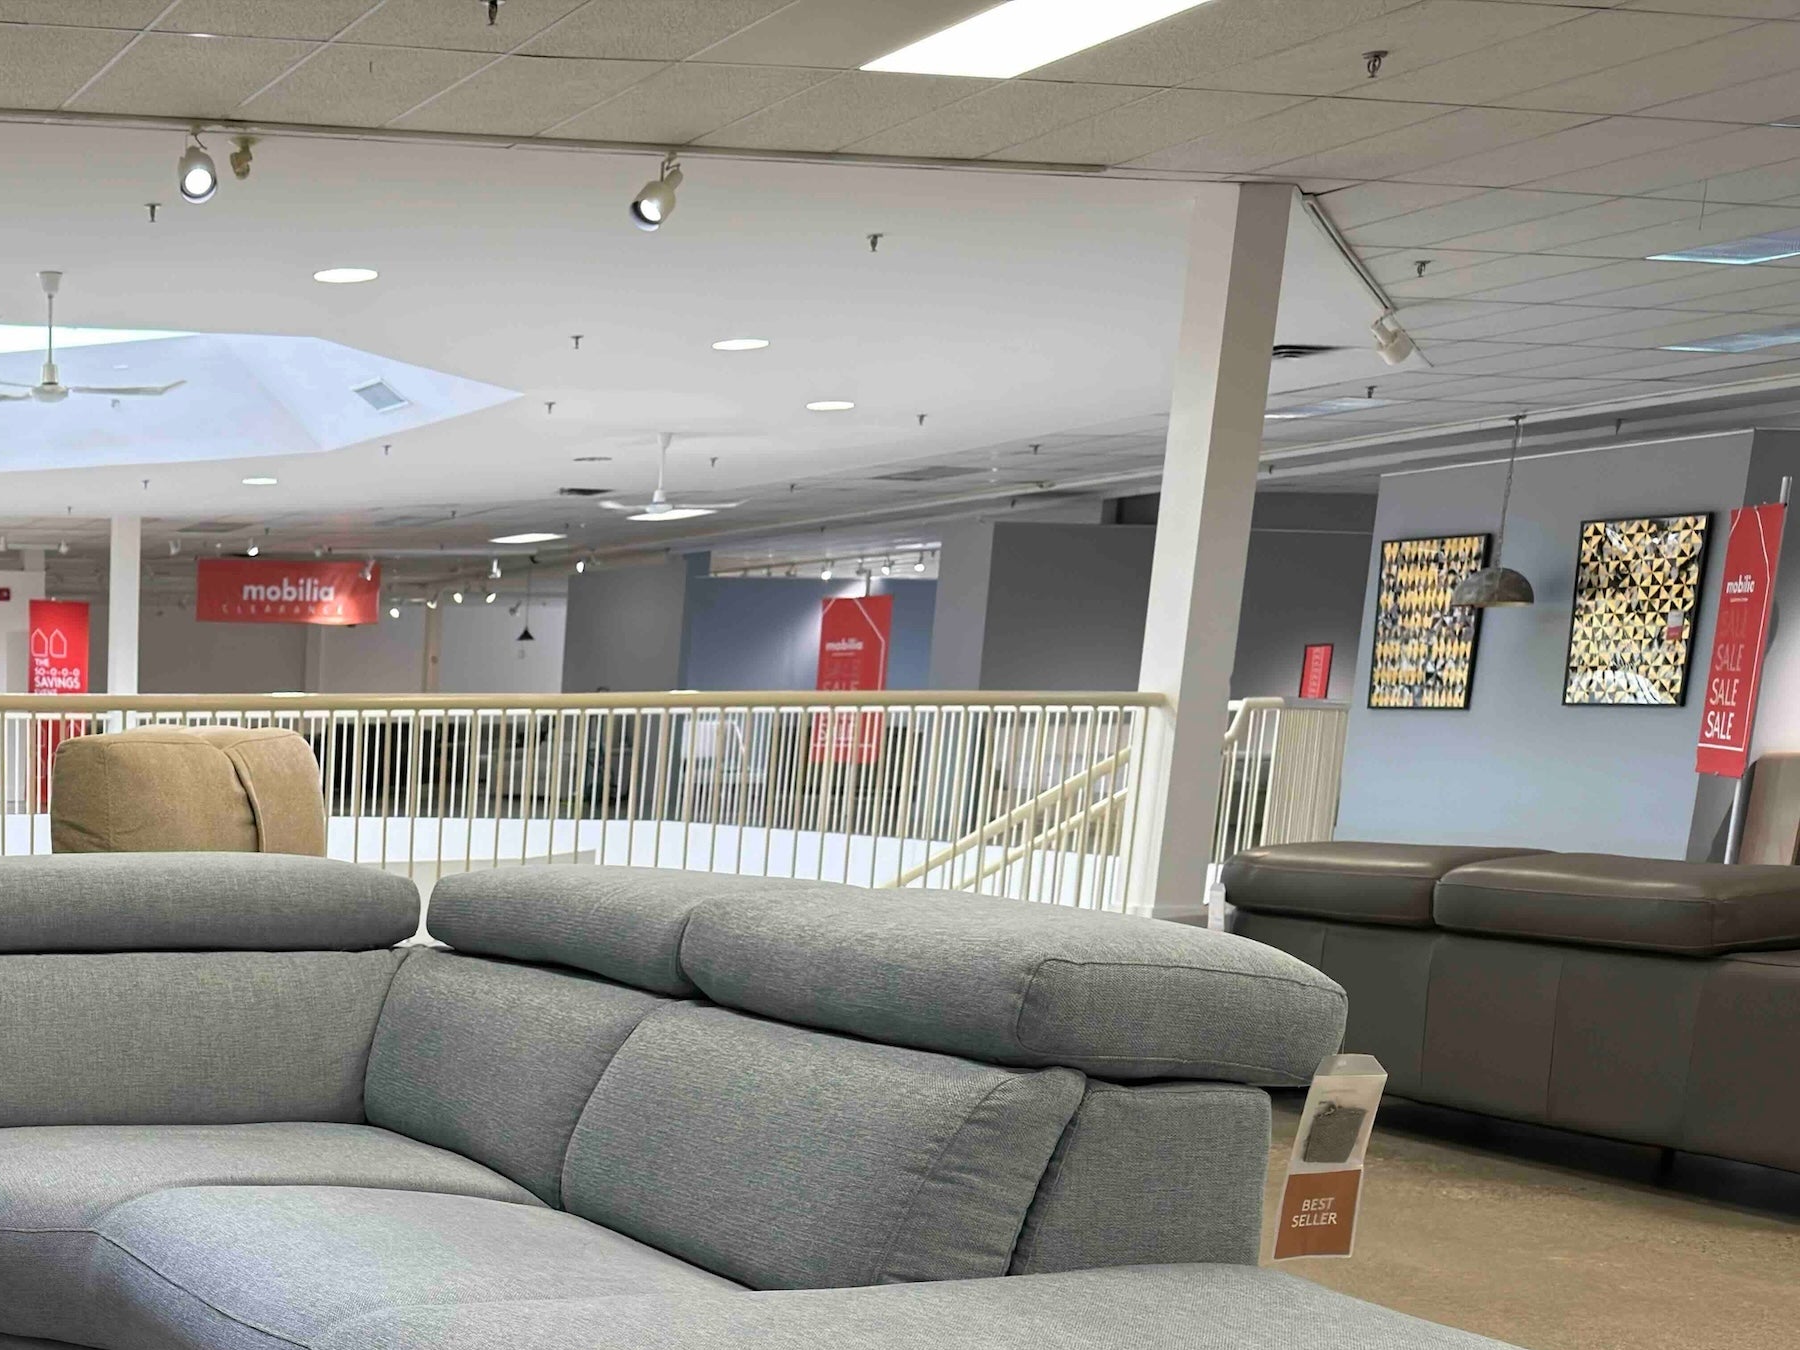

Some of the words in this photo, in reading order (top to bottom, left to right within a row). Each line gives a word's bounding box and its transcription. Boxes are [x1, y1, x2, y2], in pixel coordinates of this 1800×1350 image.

[242, 577, 336, 602] mobilia
[1726, 574, 1755, 594] mobilia
[221, 604, 344, 615] CLEARANCE
[1714, 643, 1745, 672] SALE
[34, 676, 81, 690] SAVINGS
[1709, 677, 1740, 707] SALE
[1704, 710, 1735, 740] SALE
[1301, 1197, 1335, 1212] BEST
[1291, 1212, 1338, 1228] SELLER
